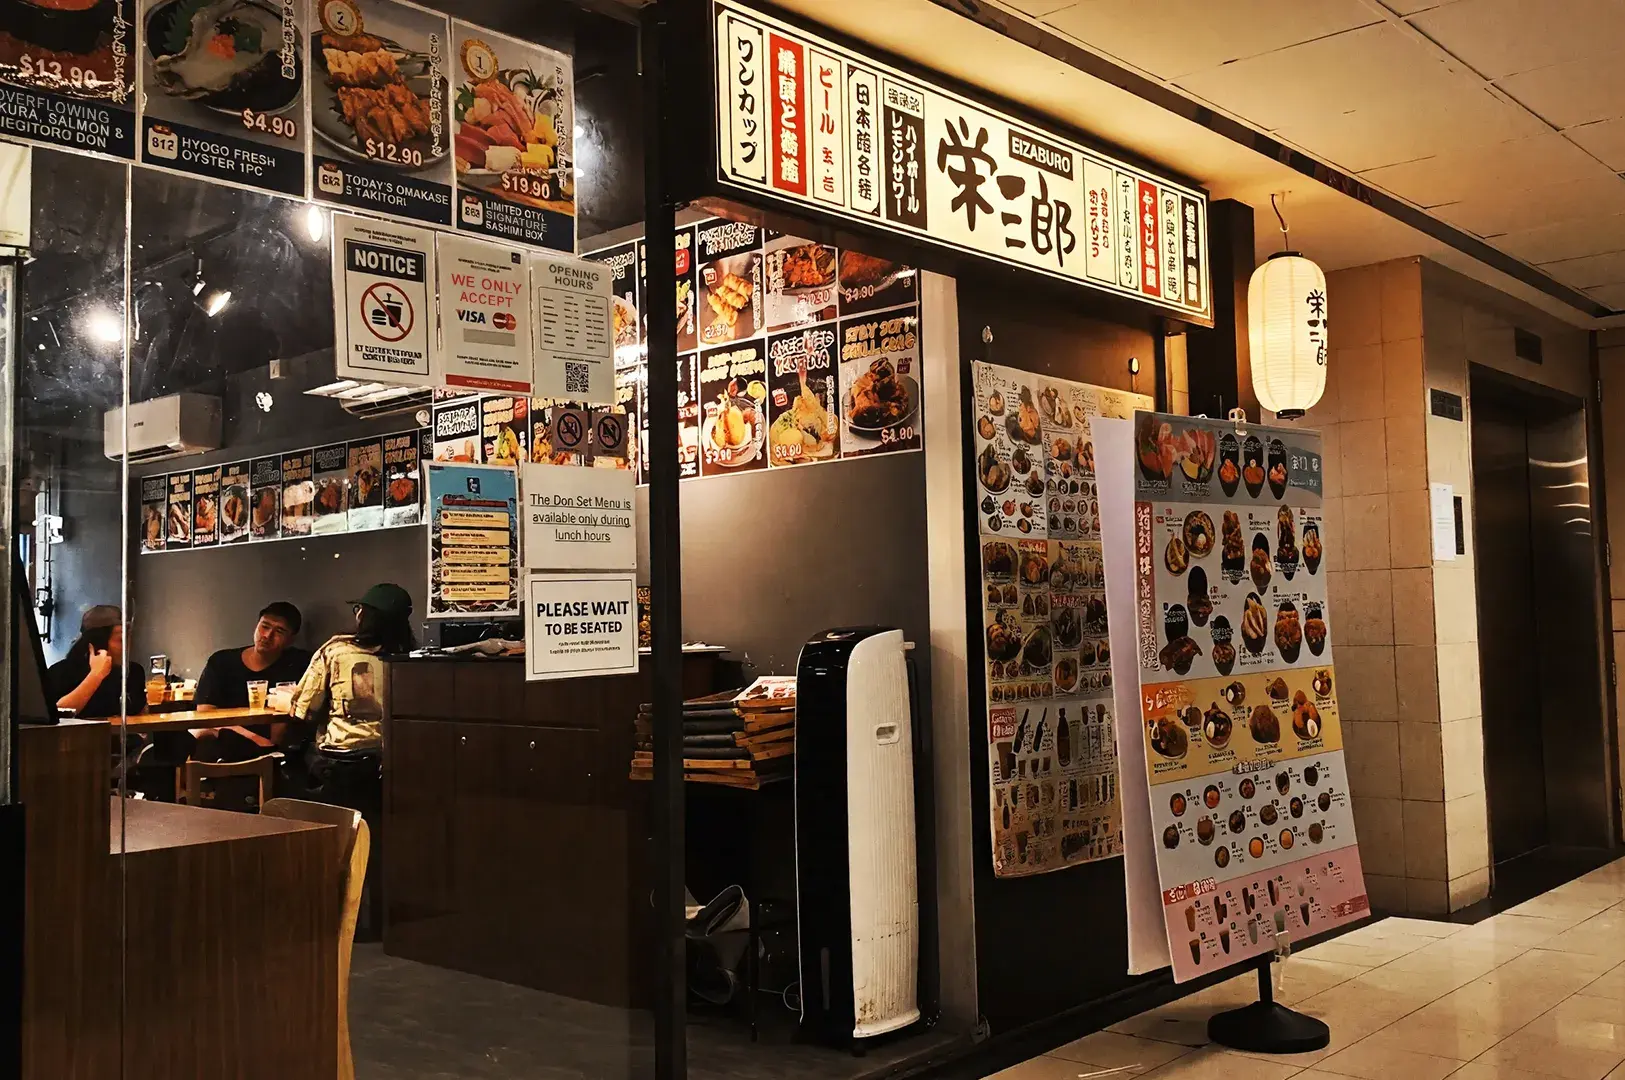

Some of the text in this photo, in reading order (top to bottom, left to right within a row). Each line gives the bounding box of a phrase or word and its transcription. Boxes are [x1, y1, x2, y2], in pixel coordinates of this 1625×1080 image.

[819, 64, 836, 135] ビール
[48, 112, 110, 137] SALMON
[242, 108, 296, 138] $4.90
[76, 132, 107, 148] DON
[182, 137, 276, 168] HYOGO FRESH
[365, 137, 422, 167] $12.90
[1011, 136, 1071, 174] EIZABURO
[182, 150, 263, 176] OYSTER 1PC
[345, 173, 449, 205] TODAY'S OMAKASE
[501, 172, 550, 199] $19.90
[485, 200, 522, 216] LIMITED
[485, 211, 548, 232] SIGNATURE
[485, 221, 544, 241] SASHIMI BOX
[354, 248, 417, 276] NOTICE
[549, 264, 600, 282] OPENING
[554, 276, 594, 290] HOURS
[451, 273, 522, 295] WE ONLY
[460, 291, 513, 308] ACCEPT
[455, 308, 486, 324] VISA
[530, 494, 632, 508] The Don Set Menu is
[532, 511, 630, 528] available only during
[555, 528, 611, 542] lunch hours
[536, 600, 629, 618] PLEASE WAIT
[545, 620, 623, 636] TO BE SEATED
